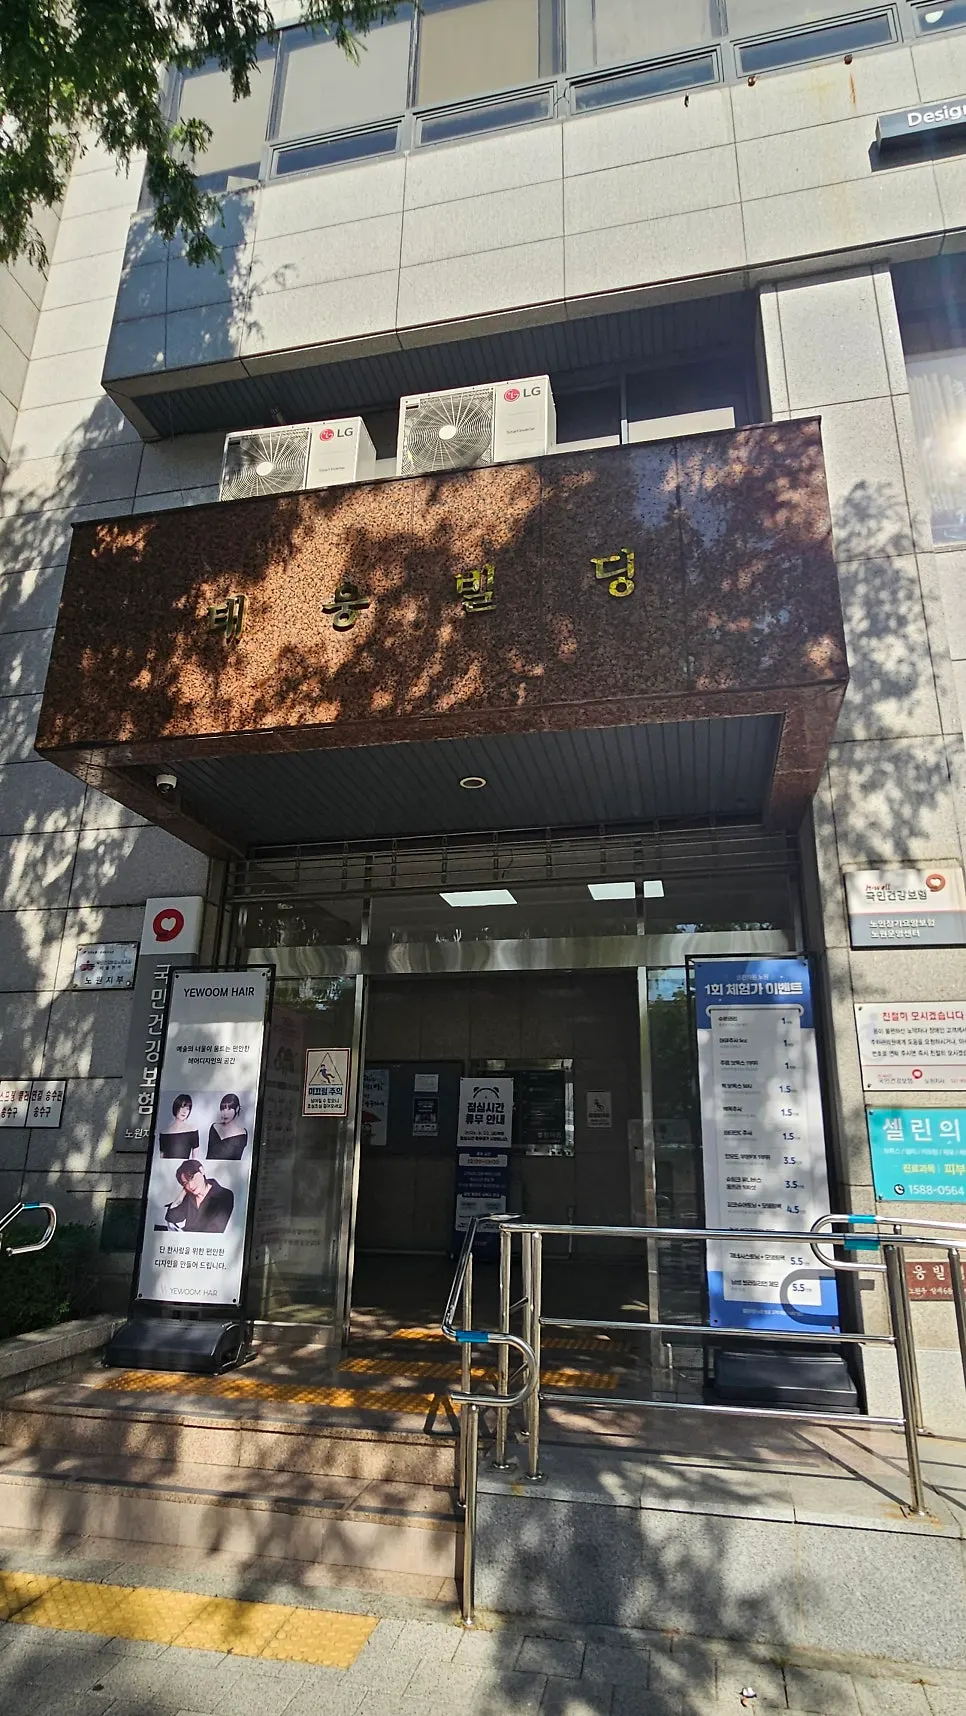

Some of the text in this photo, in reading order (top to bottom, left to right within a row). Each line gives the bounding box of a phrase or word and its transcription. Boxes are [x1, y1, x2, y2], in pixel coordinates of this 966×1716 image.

[523, 386, 541, 398] LG
[337, 427, 353, 438] LG
[865, 890, 927, 901] 국민건강보험
[183, 986, 255, 997] YEWOOM HAIR
[705, 982, 803, 995] 1회 체험가 이벤트
[138, 964, 171, 1115] 국민건강보험
[308, 1087, 343, 1096] 미끄럼 주의
[1, 1106, 18, 1118] 송수구
[33, 1106, 51, 1118] 송수구
[467, 1102, 505, 1113] 점심시간
[486, 1114, 505, 1125] 안내
[907, 1184, 965, 1196] 1588-0564
[159, 1246, 166, 1254] 단
[192, 1247, 204, 1256] 위한
[206, 1247, 225, 1257] 편안한
[154, 1260, 178, 1269] 디자인을
[199, 1261, 227, 1270] 드립니다.
[169, 1288, 218, 1296] YEWOOM HAIR
